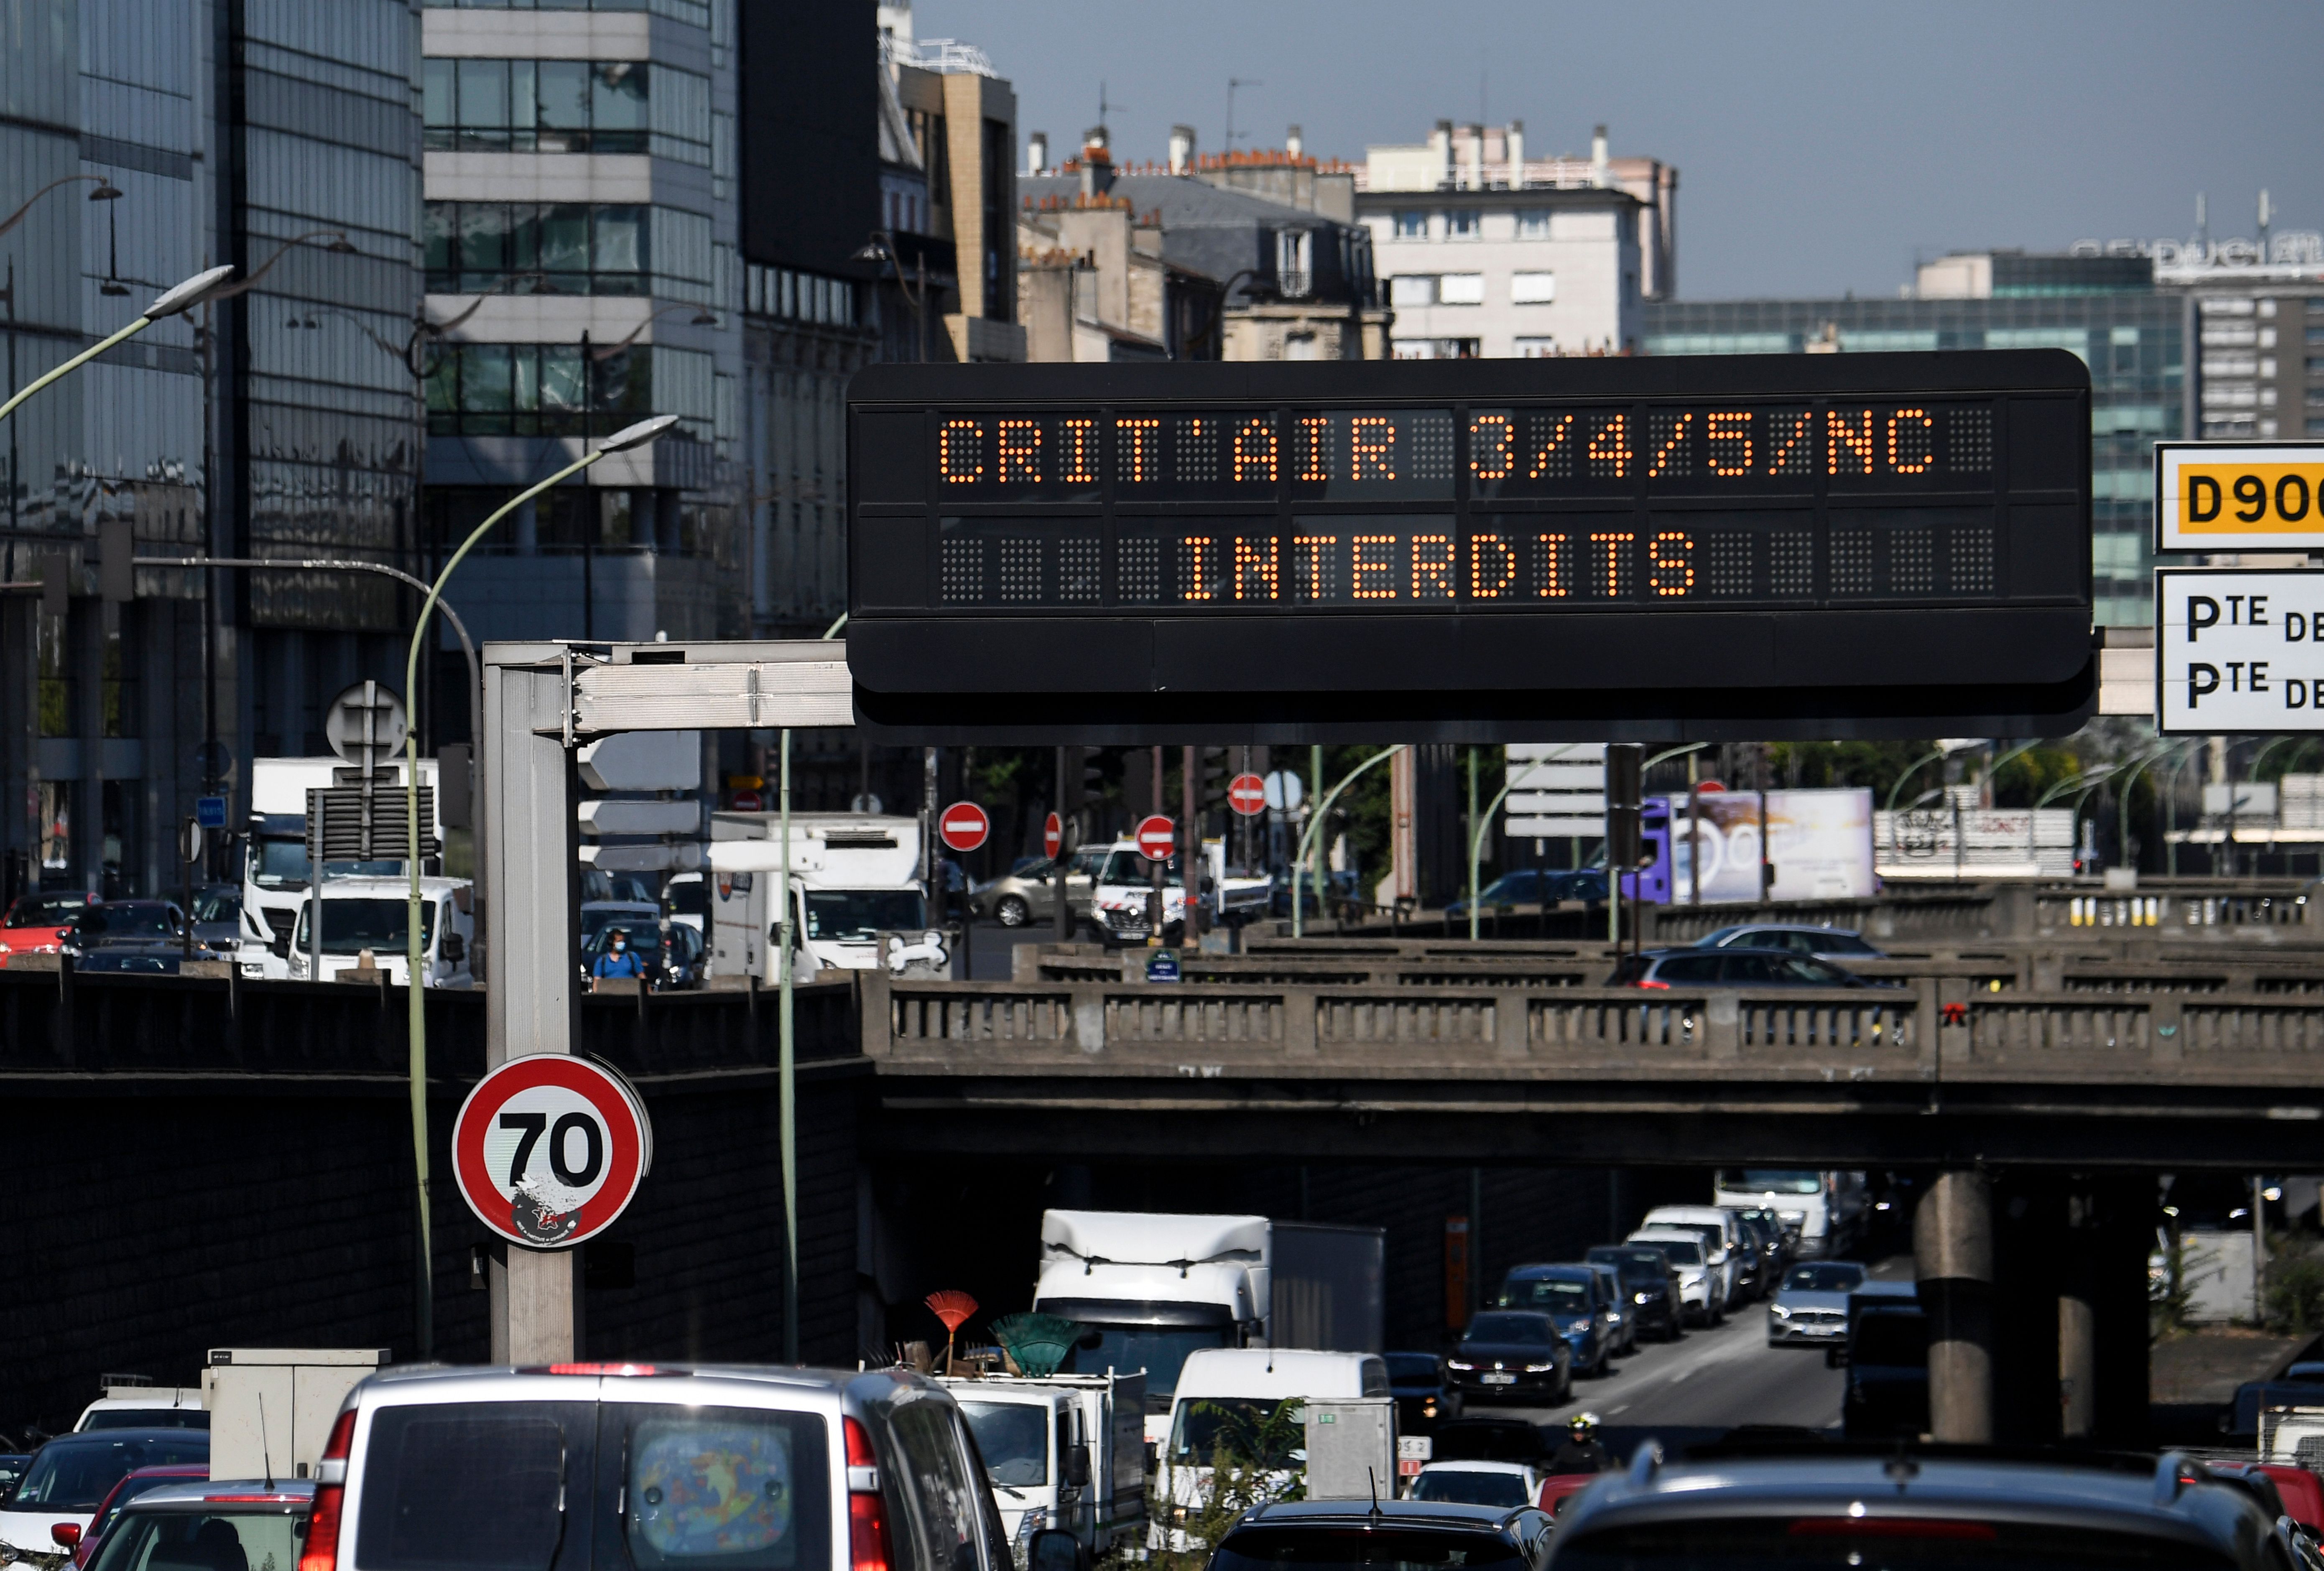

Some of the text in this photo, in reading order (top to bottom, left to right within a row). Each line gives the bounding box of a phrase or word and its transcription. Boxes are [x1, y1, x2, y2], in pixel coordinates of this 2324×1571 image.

[939, 408, 1934, 484] CRIT'AIR 3/4/5/NC
[2189, 474, 2324, 523] D90
[1184, 531, 1695, 601] INTERDITS
[499, 1112, 603, 1187] 70
